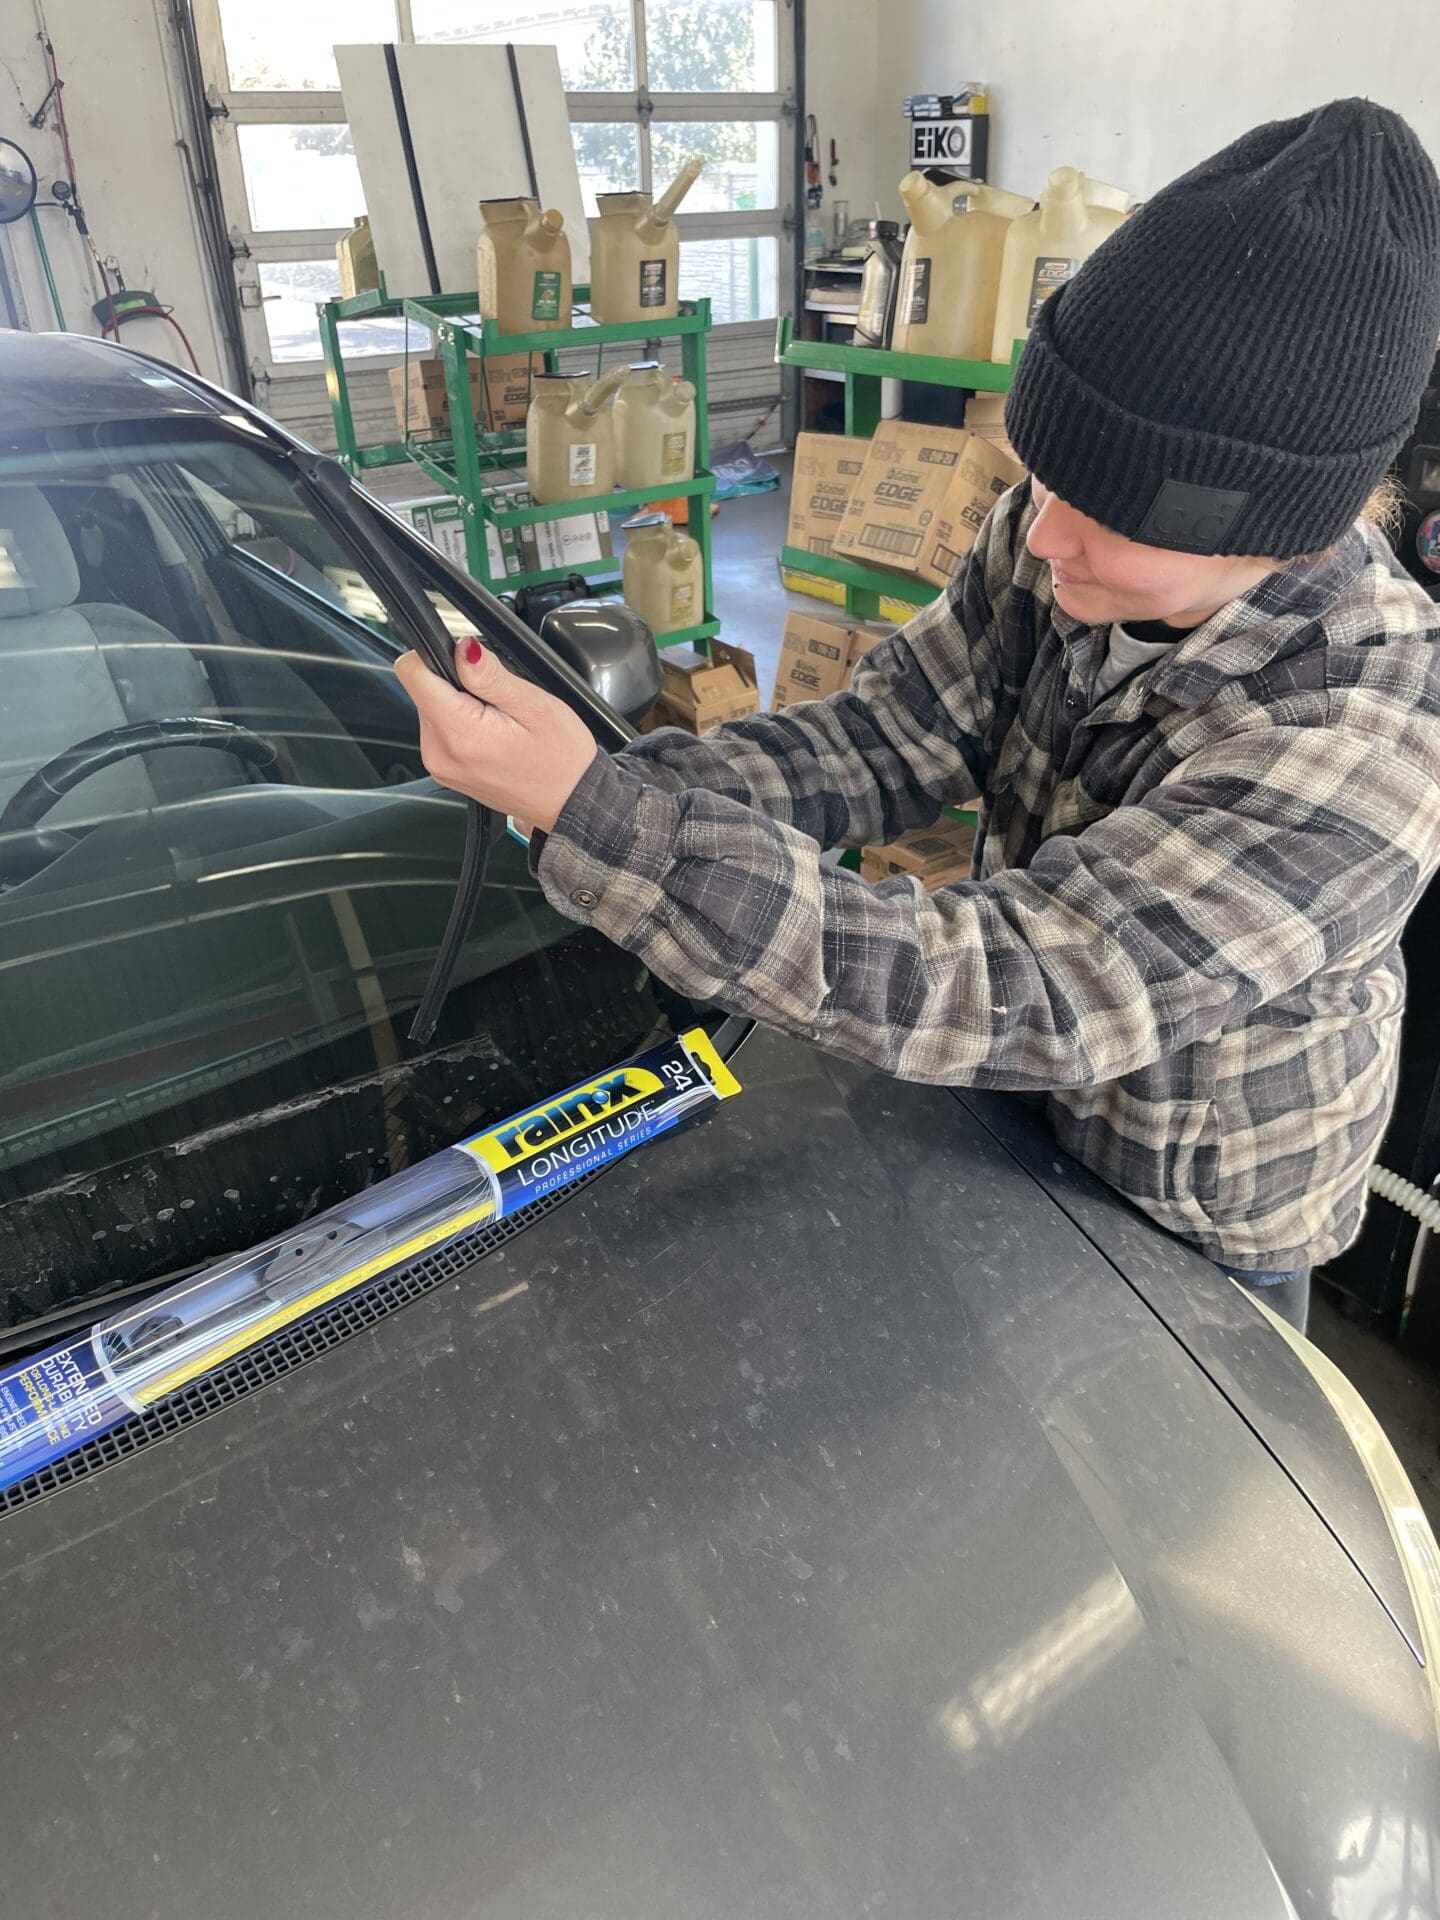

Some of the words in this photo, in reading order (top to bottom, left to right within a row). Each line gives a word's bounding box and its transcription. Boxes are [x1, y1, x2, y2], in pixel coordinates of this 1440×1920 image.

[810, 496, 850, 513] EDGE
[874, 482, 924, 503] EDGE
[790, 669, 821, 688] EDGE
[661, 1060, 693, 1091] 24
[516, 1104, 656, 1187] LONGITUDE
[534, 1148, 614, 1195] PROFESSIONAL
[617, 1126, 653, 1151] SERIES
